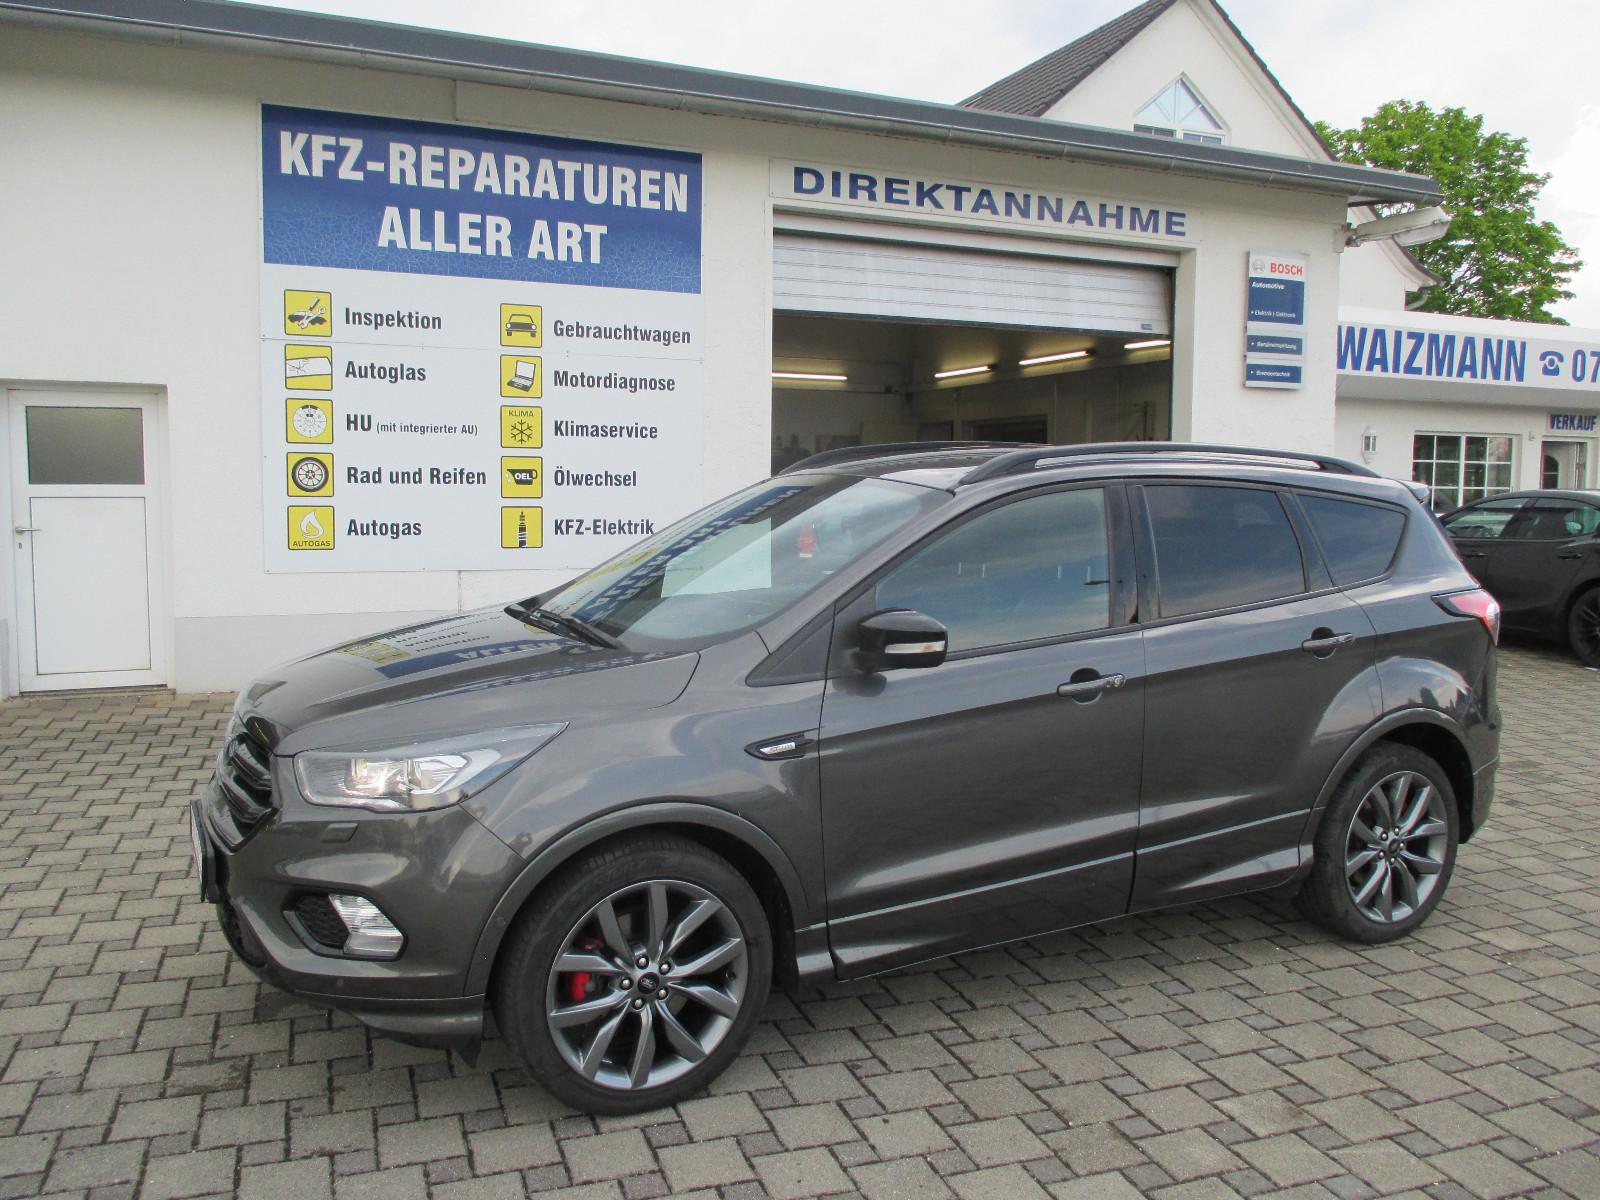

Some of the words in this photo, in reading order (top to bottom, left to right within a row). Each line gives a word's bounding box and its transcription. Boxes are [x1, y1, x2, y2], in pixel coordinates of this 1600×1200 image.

[279, 130, 689, 213] KFZ-REPARATUREN
[793, 166, 1187, 237] DIREKTANNAHME
[377, 206, 513, 257] ALLER
[527, 220, 608, 264] ART
[1270, 262, 1303, 276] BOSCH
[1251, 281, 1285, 290] Automotive
[345, 308, 442, 330] Inspektion
[553, 319, 691, 346] Gebrauchtwagen
[1336, 325, 1527, 383] WAIZMANN
[345, 360, 427, 384] Autoglas
[553, 370, 676, 394] Motordiagnose
[508, 409, 534, 418] KLIMA
[1550, 413, 1597, 432] VERKAUF
[346, 413, 372, 432] HU
[376, 421, 397, 434] (mit
[400, 422, 458, 436] integrierter
[460, 424, 478, 436] AU)
[554, 420, 658, 439] Klimaservice
[347, 467, 382, 484] Rad
[389, 468, 422, 485] und
[429, 467, 487, 485] Reifen
[515, 472, 532, 480] OEL
[554, 466, 637, 487] Ölwechsel
[347, 519, 422, 540] Autogas
[554, 519, 655, 536] KFZ-Elektrik
